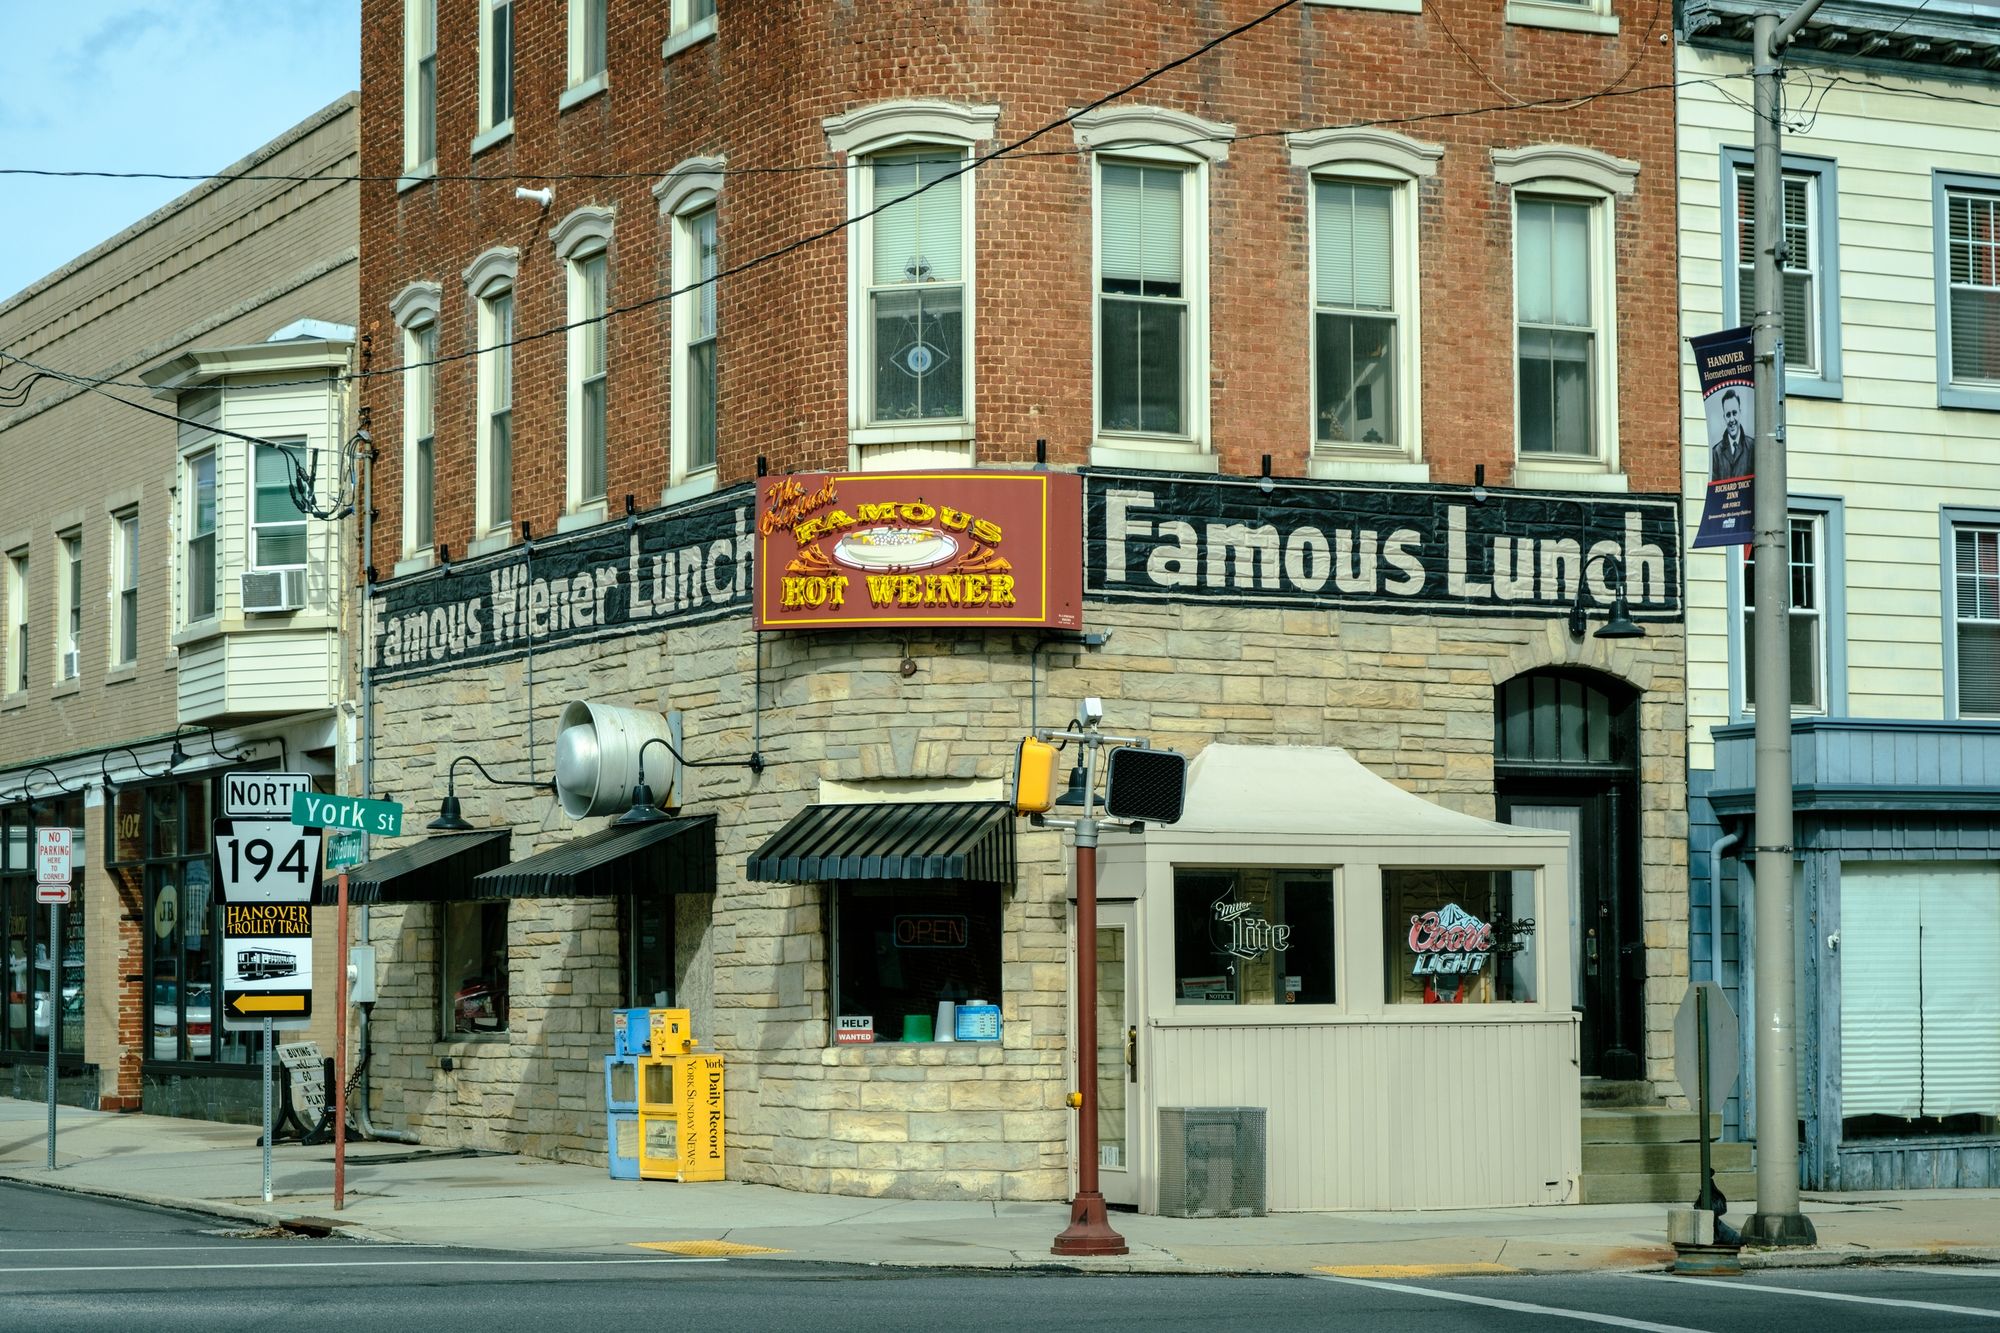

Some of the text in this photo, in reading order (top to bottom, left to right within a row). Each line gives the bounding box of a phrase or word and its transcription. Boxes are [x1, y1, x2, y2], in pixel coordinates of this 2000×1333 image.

[1707, 351, 1744, 368] HANOVER
[1703, 363, 1752, 382] Hometown Hero
[764, 477, 802, 506] The
[1715, 483, 1737, 494] RICHARD
[795, 502, 1002, 545] FAMOUS
[1105, 488, 1667, 604] Famous Lunch
[371, 507, 755, 669] Famous Wiener Lunch
[781, 574, 1016, 606] HOT WEINER
[120, 814, 141, 839] 107
[306, 798, 395, 831] York St
[48, 832, 61, 842] NO
[40, 845, 69, 856] PARKING
[228, 838, 309, 883] 194
[328, 836, 361, 863] Broadway
[70, 912, 82, 925] GOLD
[227, 905, 310, 926] HANOVER
[1216, 901, 1251, 916] Miller
[227, 919, 310, 935] TROLLEY TRAIL
[898, 919, 964, 944] OPEN
[1230, 917, 1290, 951] Lite
[1408, 911, 1492, 953] Coors
[1412, 952, 1490, 976] LIGHT
[842, 1019, 870, 1028] HELP
[838, 1033, 872, 1041] WANTED
[286, 1046, 312, 1059] BUYING
[705, 1059, 724, 1069] York
[686, 1060, 697, 1166] YORK SUNDAY NEWS
[706, 1072, 720, 1159] Daily Record
